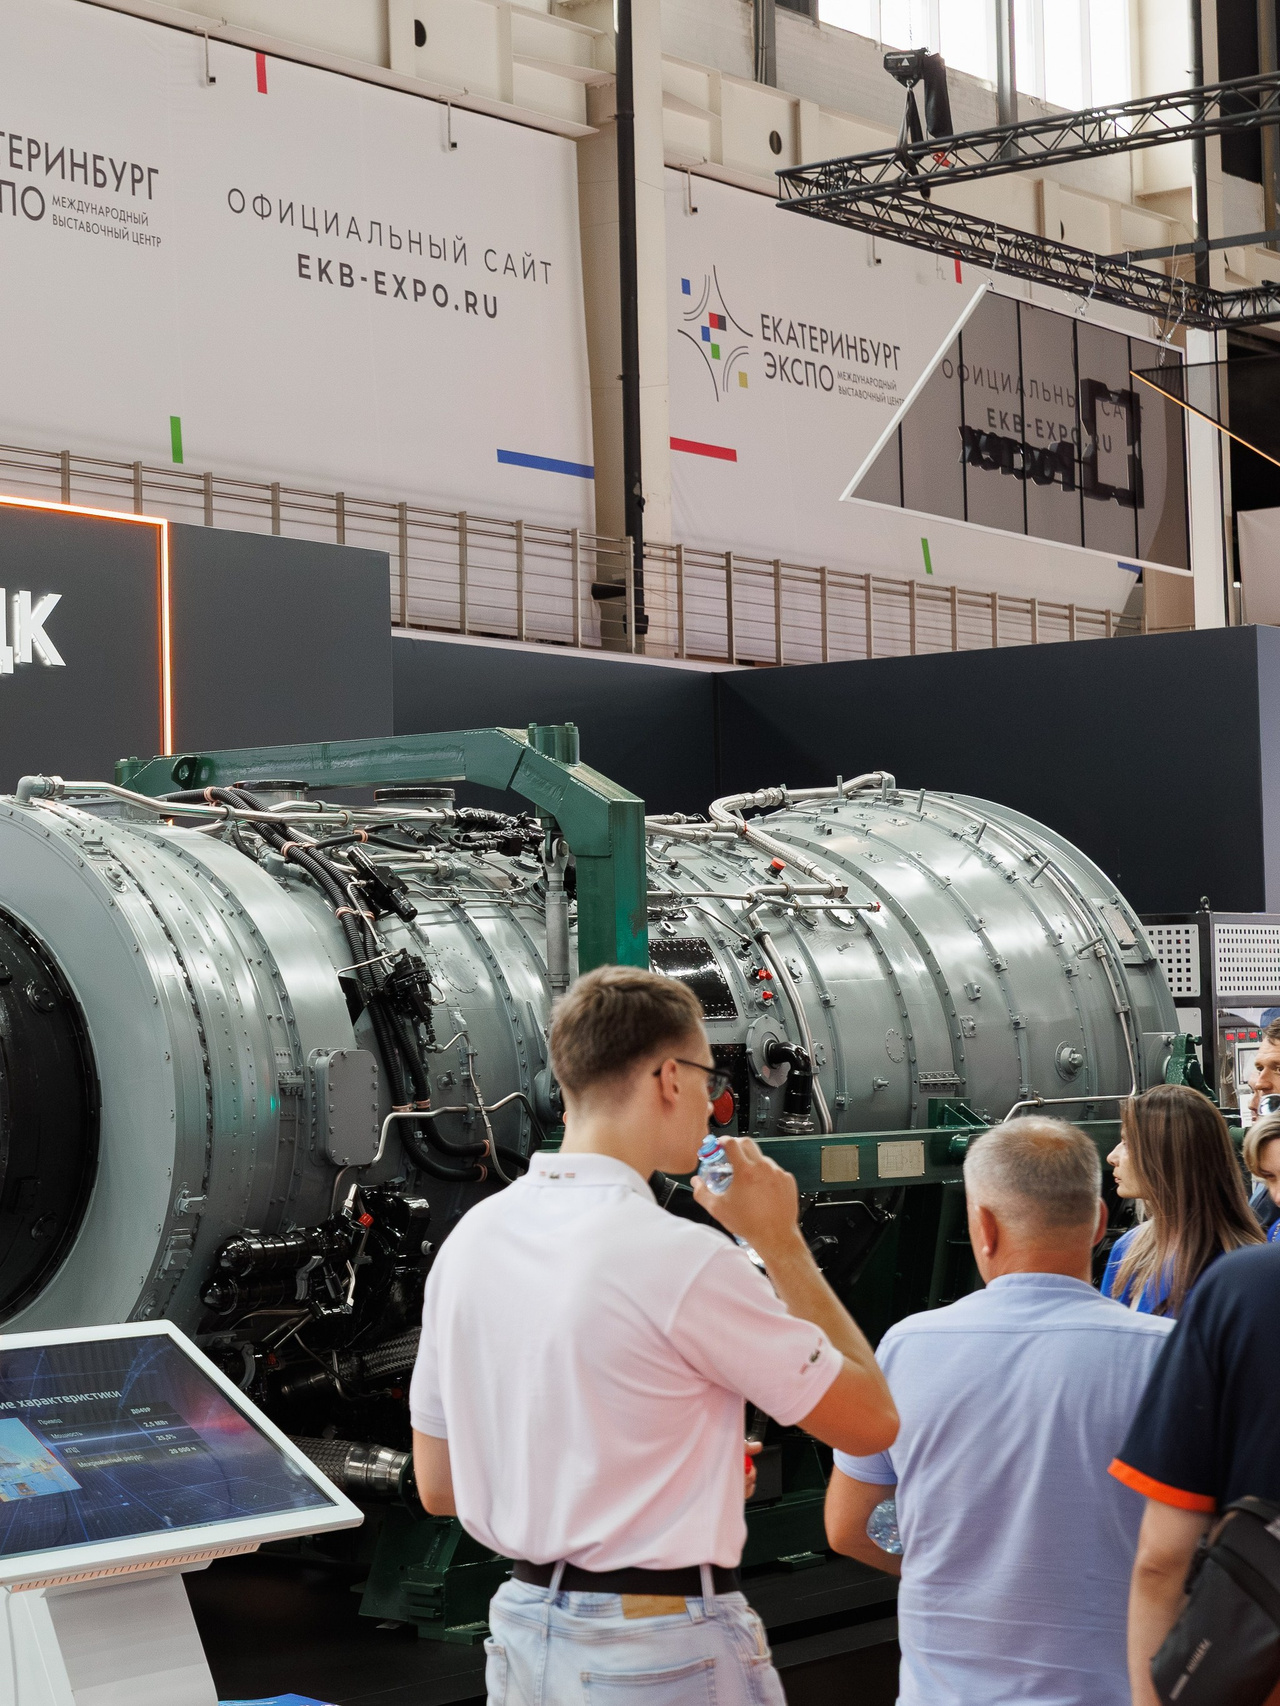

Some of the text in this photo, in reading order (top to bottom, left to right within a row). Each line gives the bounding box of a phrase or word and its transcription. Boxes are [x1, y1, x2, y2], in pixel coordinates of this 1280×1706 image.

[51, 194, 149, 227] МЕЖДУНАРОДНЫЙ
[52, 214, 162, 248] ВЫСТАВОЧНЫЙ ЦЕНТР
[227, 187, 552, 284] ОФИЦИАЛЬНЫЙ САЙТ
[297, 252, 498, 319] EKB-EXPO.RU
[760, 313, 901, 371] ЕКАТЕРИНБУРГ
[763, 351, 835, 392] ЭКСПО
[836, 370, 898, 391] МЕЖДУНАРОДНЫЙ
[838, 385, 887, 403] ВЫСТАВОЧНЫЙ
[16, 1390, 122, 1408] характеристики
